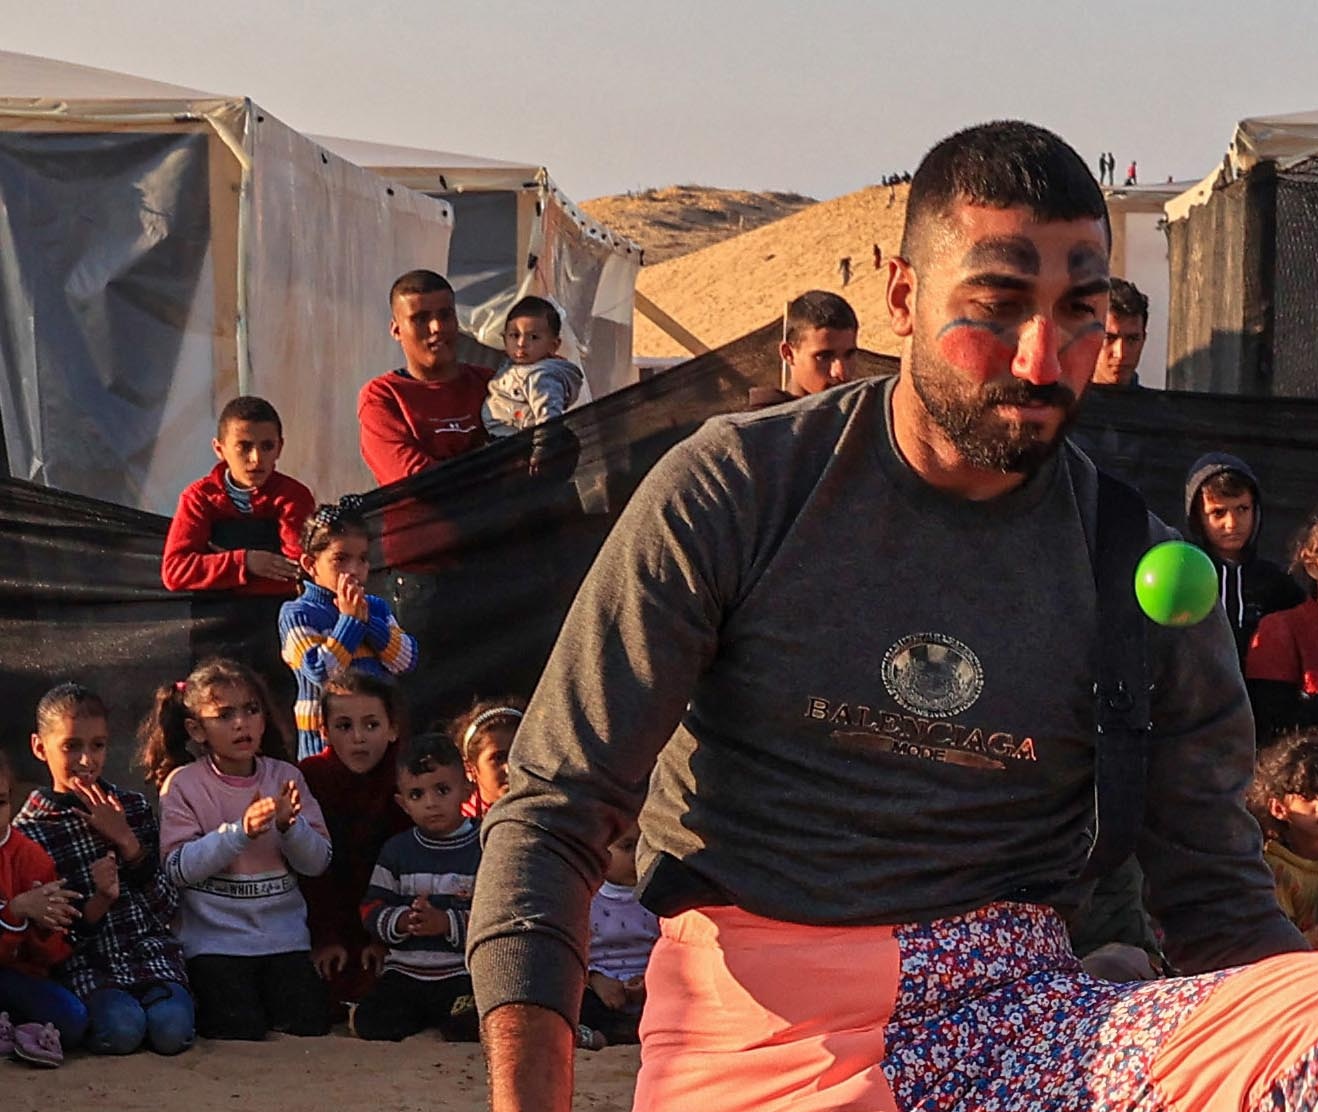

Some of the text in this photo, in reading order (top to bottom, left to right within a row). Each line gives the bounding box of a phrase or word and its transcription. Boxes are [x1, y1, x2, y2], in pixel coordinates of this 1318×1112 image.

[804, 697, 1037, 761] BALENCIAGA
[891, 741, 946, 761] MODE
[229, 883, 259, 896] WHITE
